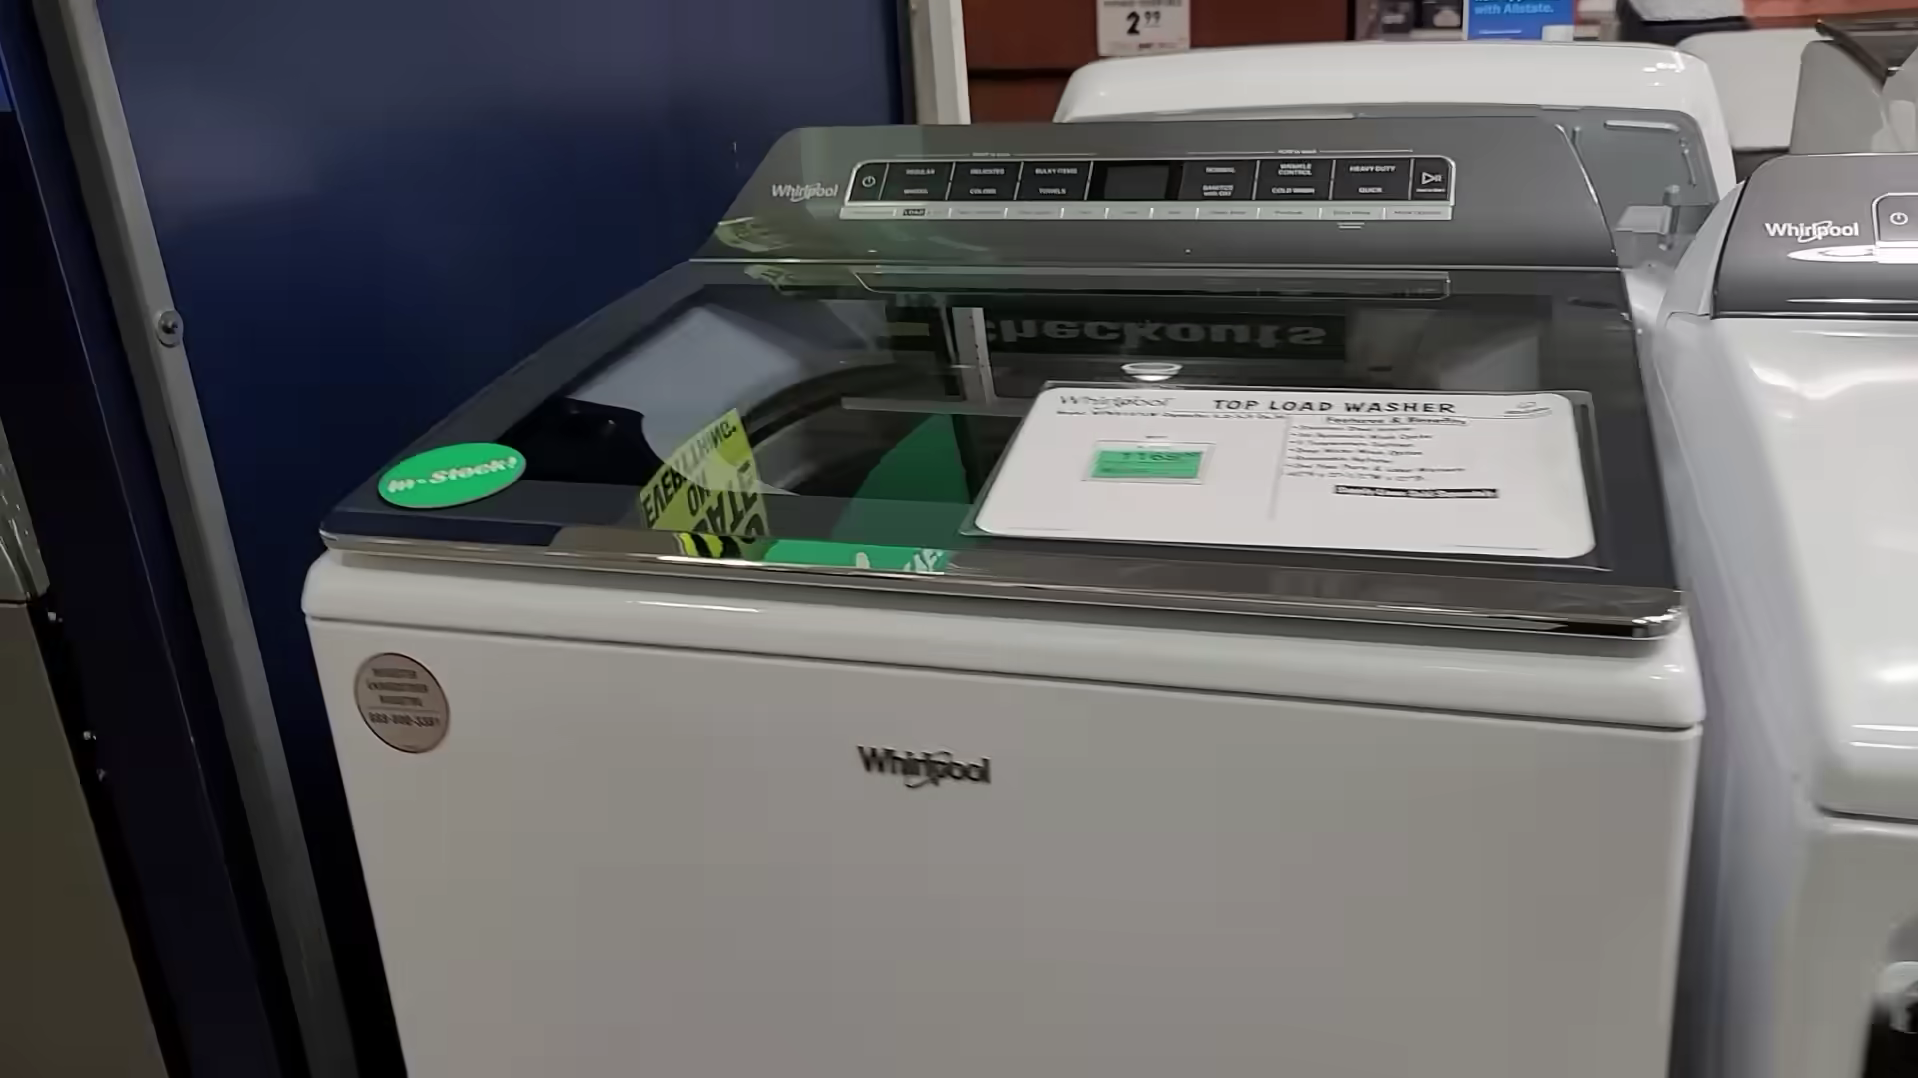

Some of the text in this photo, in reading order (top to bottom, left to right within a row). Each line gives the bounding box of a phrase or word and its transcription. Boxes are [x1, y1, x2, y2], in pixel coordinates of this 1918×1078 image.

[771, 183, 839, 202] Whirlpool
[1765, 220, 1859, 243] Whirlpool
[1213, 399, 1456, 414] TOP LOAD WASHER
[856, 744, 992, 788] Whirlpool
